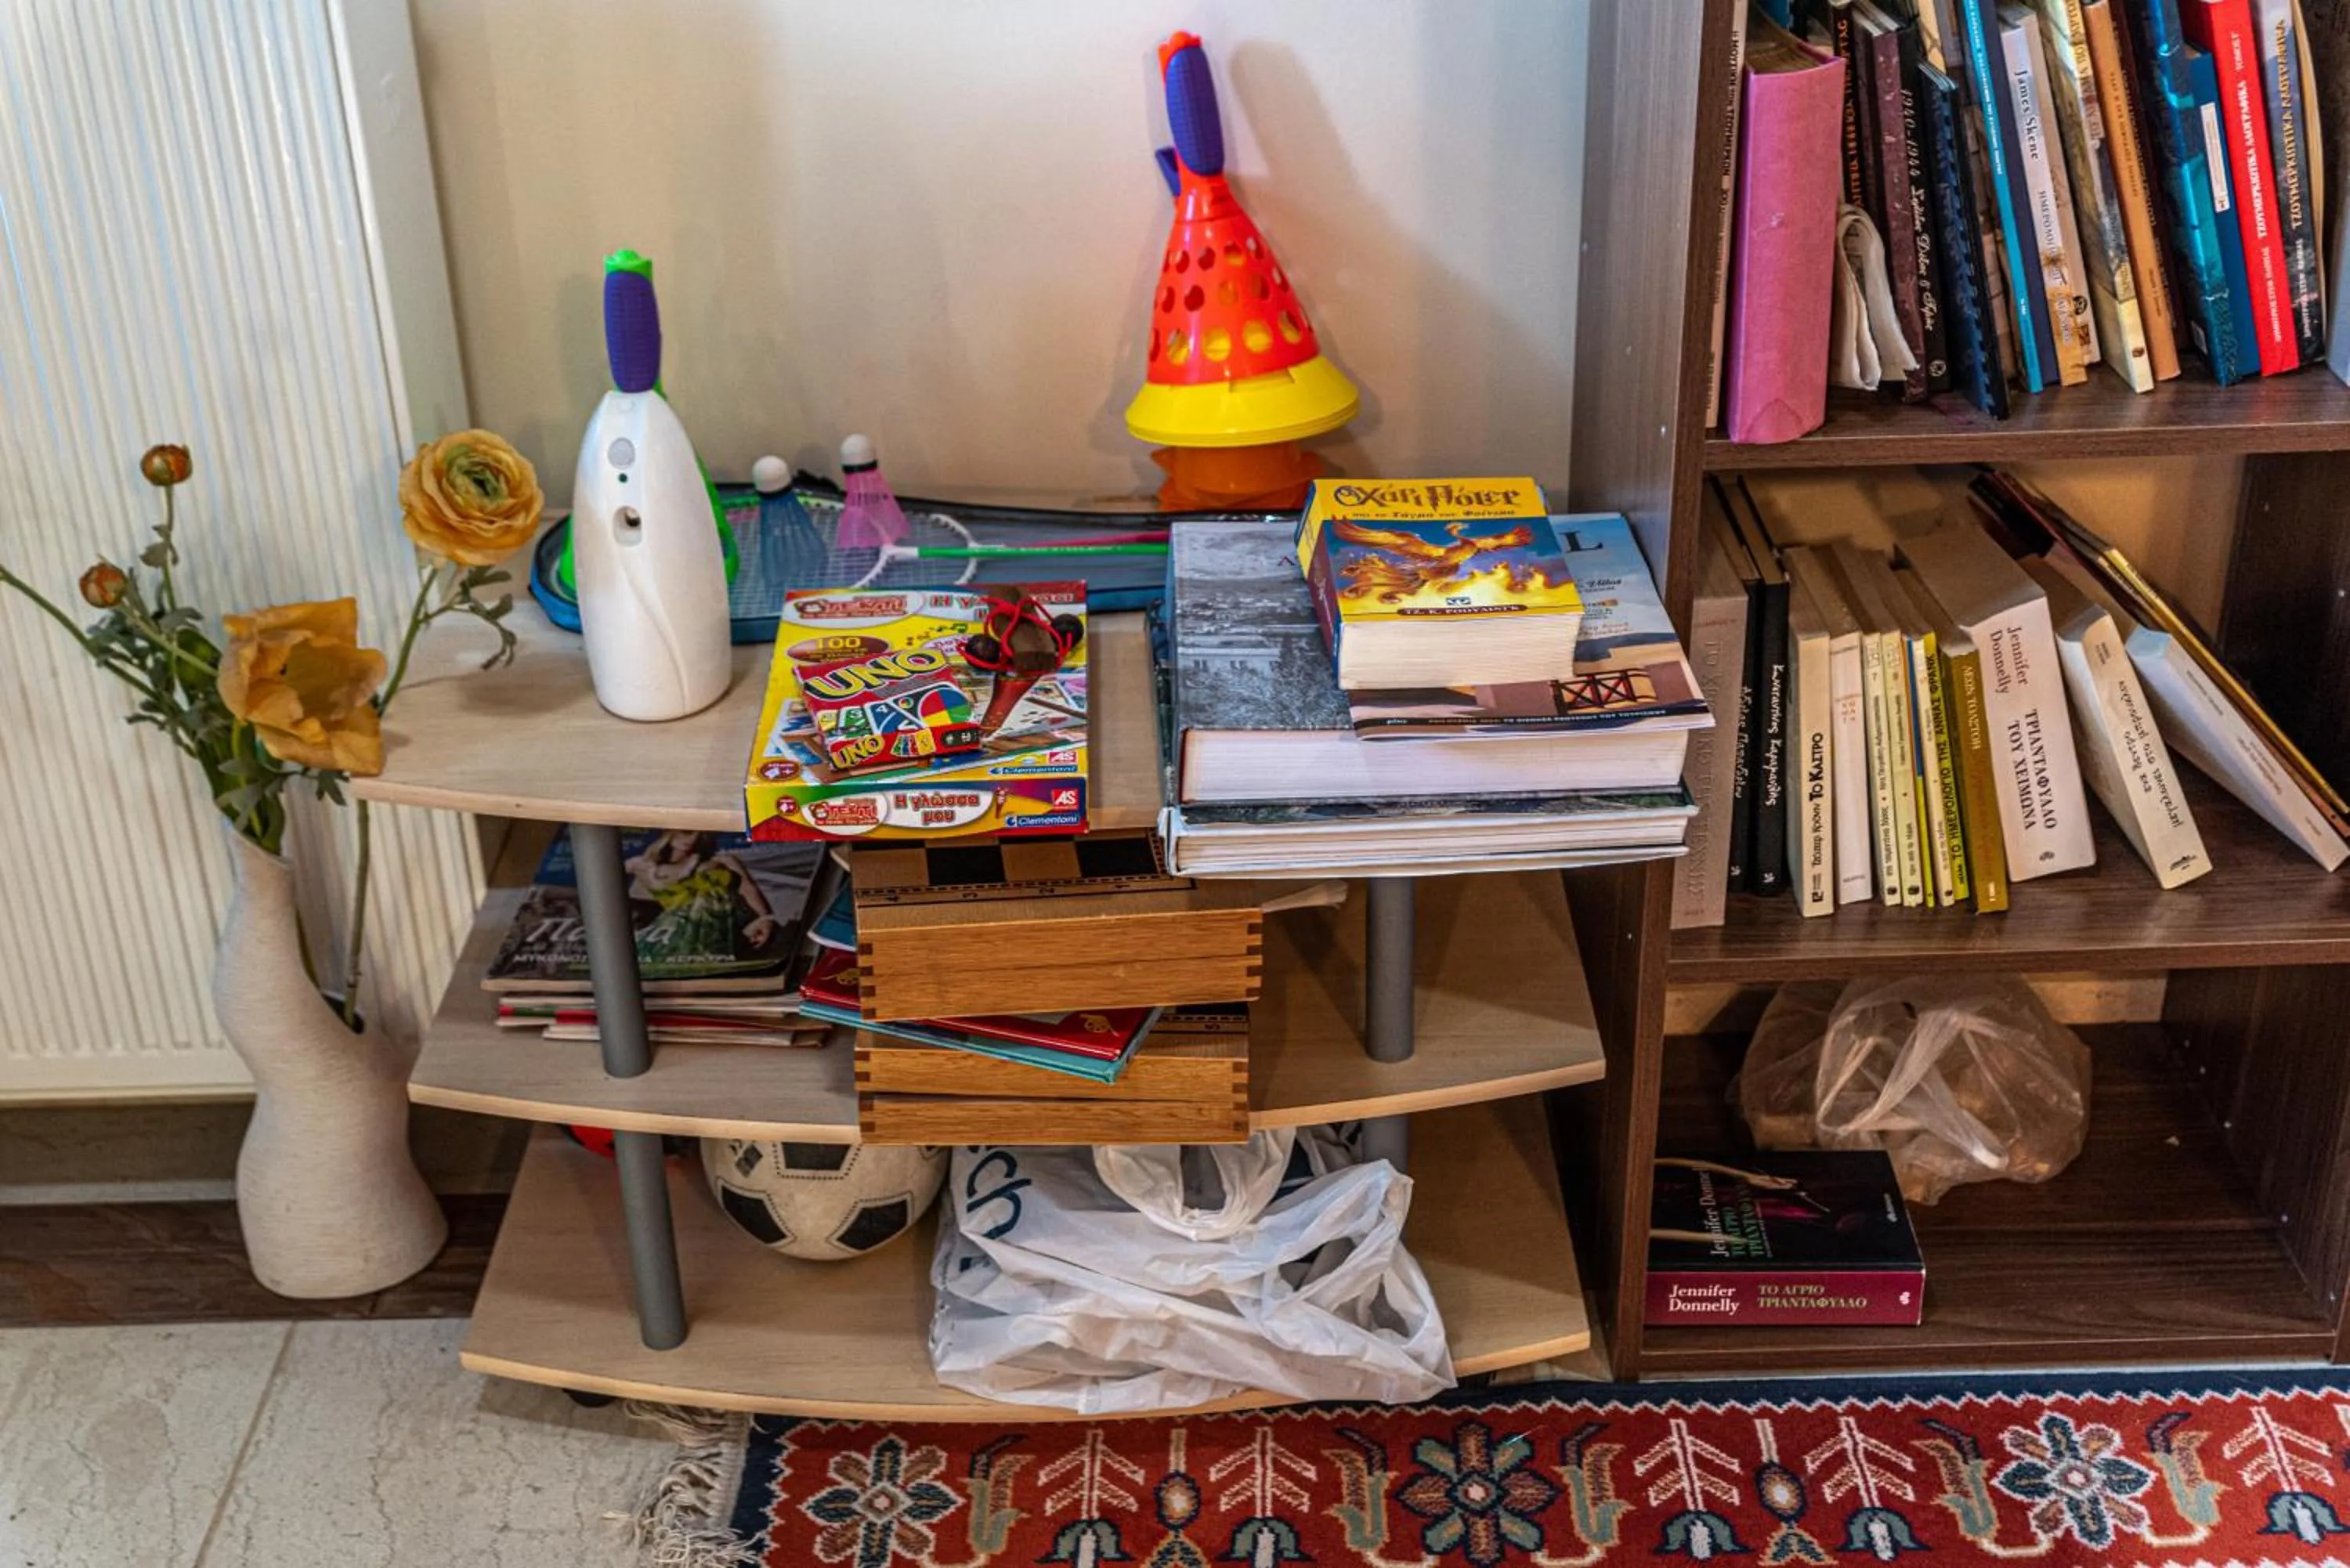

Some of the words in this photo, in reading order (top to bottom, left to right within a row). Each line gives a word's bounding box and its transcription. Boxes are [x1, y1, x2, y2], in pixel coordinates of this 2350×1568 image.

[2013, 68, 2035, 114] James
[2023, 117, 2044, 161] Skene
[2282, 111, 2304, 229] ΤΖΟΥΜΕΡΚΙΩΤΙΚΑ
[1356, 483, 1423, 508] Χάρι
[1423, 484, 1521, 512] Πότερ
[817, 637, 861, 649] 100
[2007, 626, 2030, 686] Jennifer
[804, 649, 947, 699] UNO
[1924, 653, 1939, 693] ΦΡΑΝΚ
[1990, 629, 2011, 694] Donnelly
[1930, 697, 1945, 735] ΑΝΝΑΣ
[831, 734, 884, 768] UNO
[1936, 739, 1948, 761] ΤΗΣ
[2008, 721, 2023, 753] ΤΟΥ
[1050, 752, 1075, 762] AS
[2025, 709, 2058, 829] ΤΡΙΑΝΤΑΦΥΛΛΟ
[894, 795, 907, 808] Η
[910, 793, 980, 811] γλώσσα
[1054, 791, 1077, 805] AS
[1940, 767, 1960, 839] ΗΜΕΡΟΛΟΓΙΟ
[2013, 757, 2037, 830] ΧΕΙΜΩΝΑ
[922, 810, 955, 827] μου
[1018, 815, 1077, 826] Clementoni
[1950, 844, 1963, 859] ΤΟ
[1669, 1284, 1736, 1298] Jennifer
[1757, 1285, 1778, 1295] ΤΟ
[1783, 1285, 1824, 1295] ΑΓΡΙΟ
[1757, 1297, 1867, 1308] ΤΡΙΑΝΤΑΦΥΛΛΟ
[1668, 1298, 1740, 1316] Donnelly
